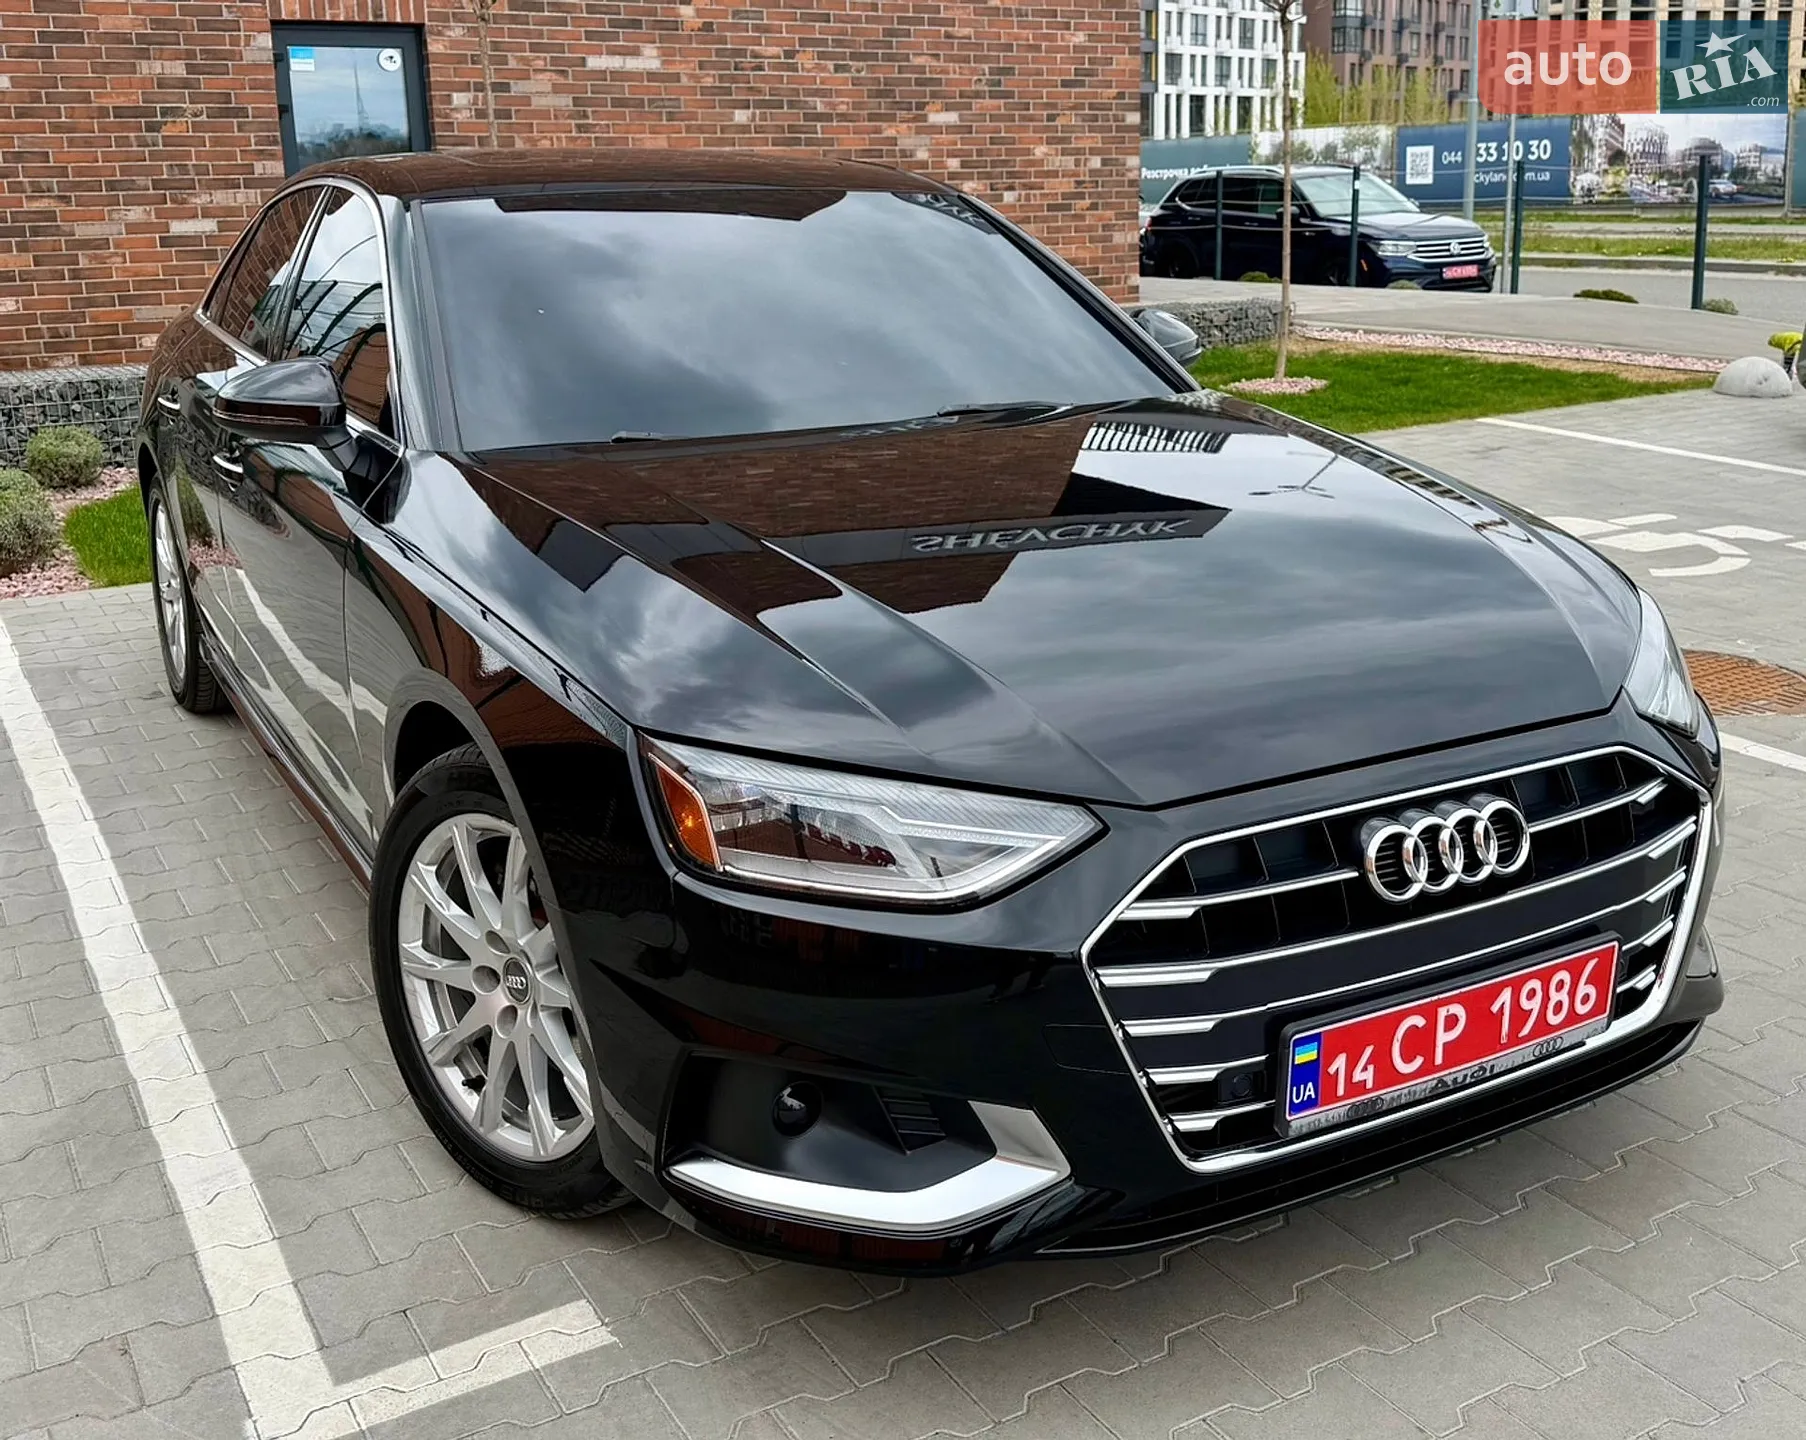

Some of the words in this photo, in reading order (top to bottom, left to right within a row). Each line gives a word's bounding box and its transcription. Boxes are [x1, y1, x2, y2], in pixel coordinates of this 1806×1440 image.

[1441, 151, 1463, 165] 044
[1501, 141, 1523, 161] 10
[1527, 139, 1551, 161] 30
[1327, 1044, 1375, 1098] 14
[1391, 1002, 1467, 1075] CP
[1490, 957, 1601, 1045] 1986
[1292, 1081, 1316, 1104] UA
